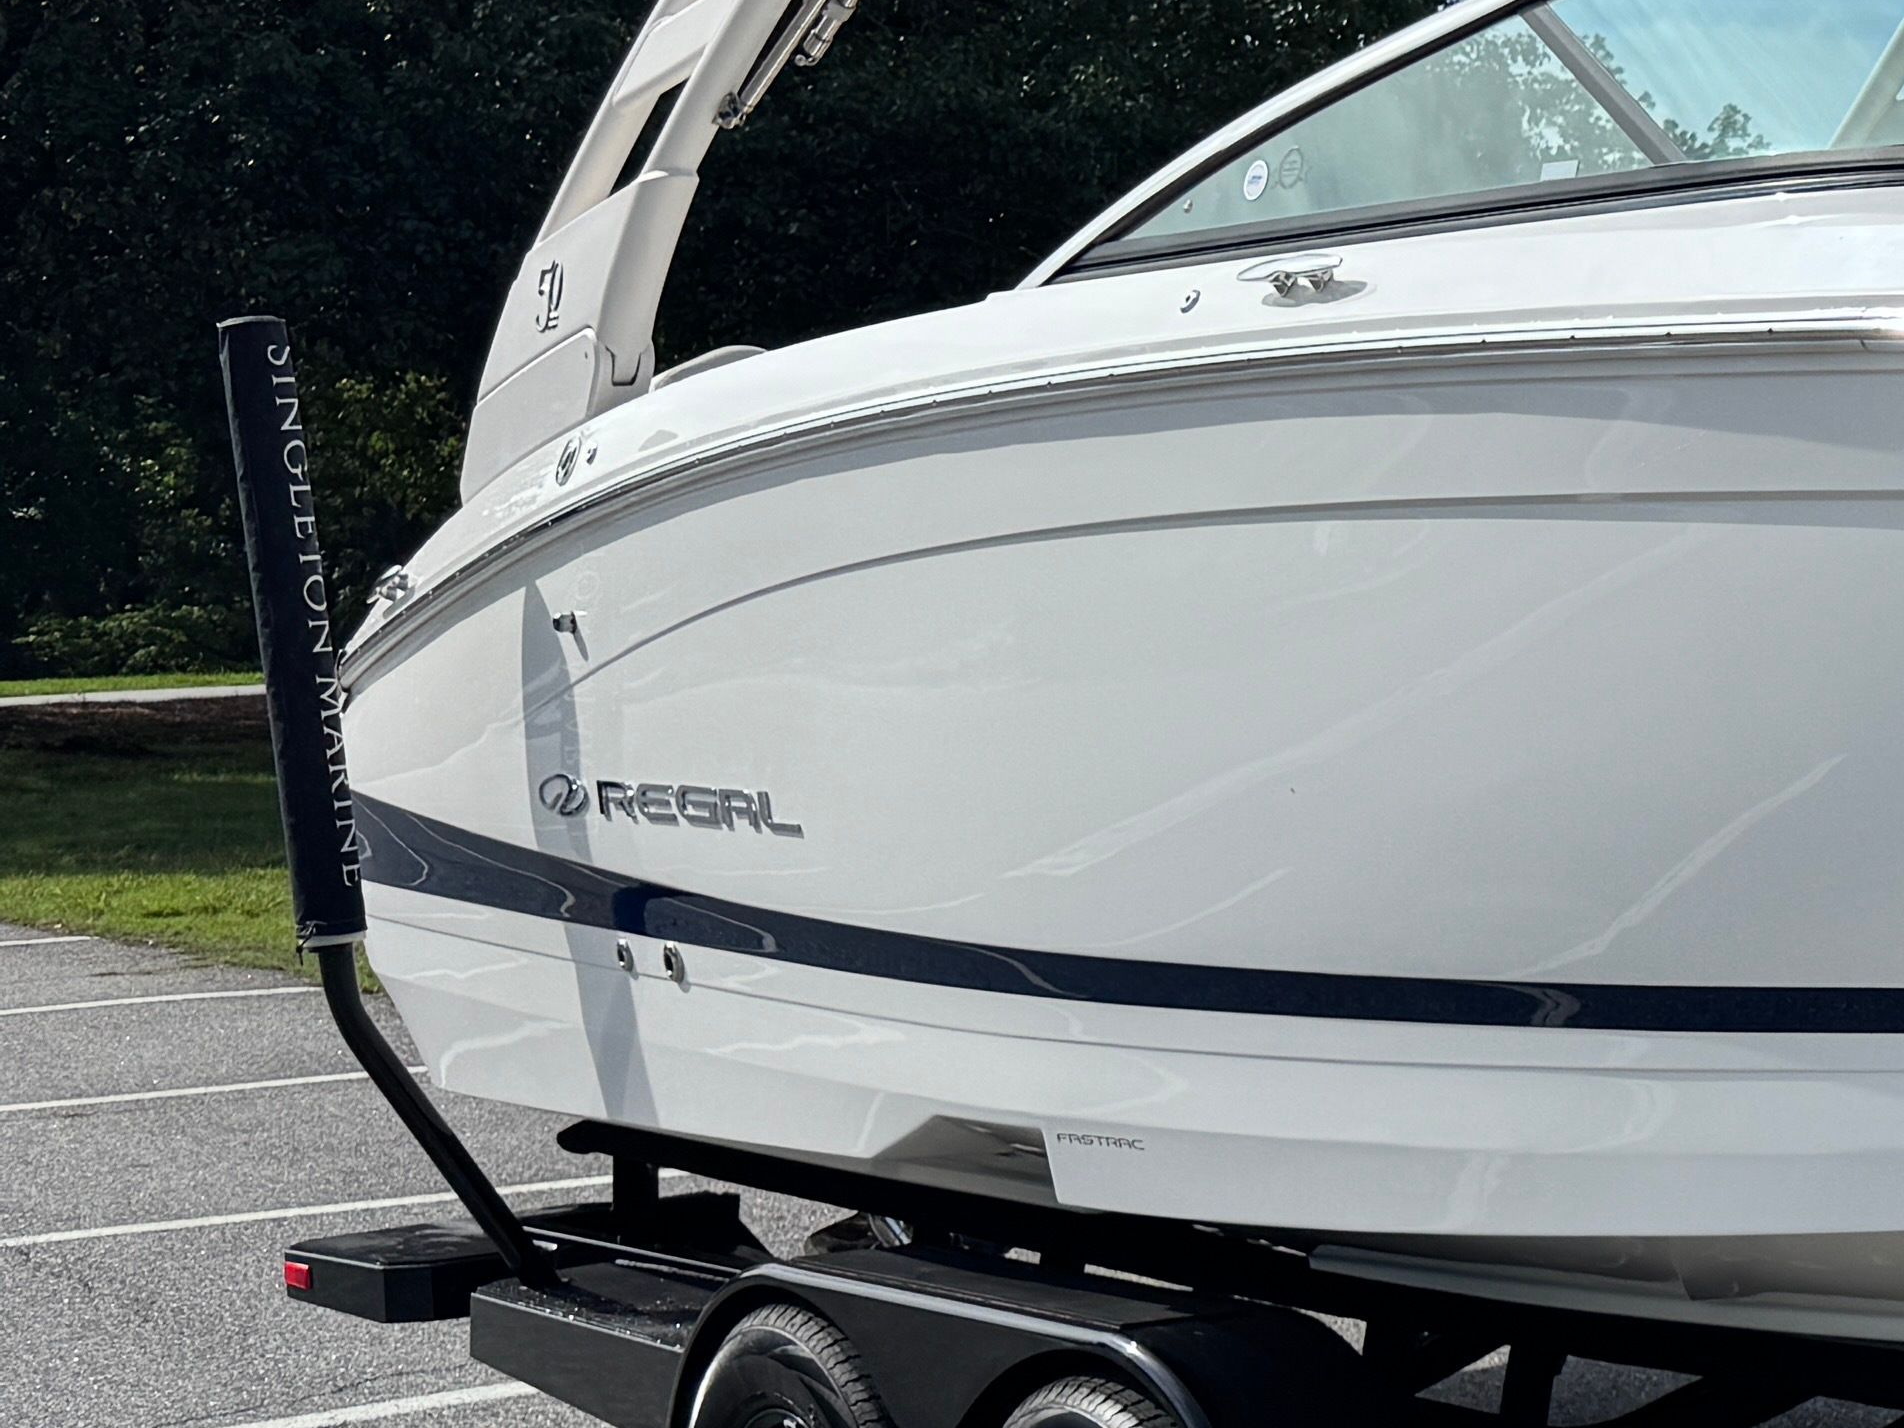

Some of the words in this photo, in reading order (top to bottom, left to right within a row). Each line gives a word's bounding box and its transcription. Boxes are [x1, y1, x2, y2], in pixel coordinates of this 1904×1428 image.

[265, 343, 334, 654] SINGLETON
[316, 674, 361, 888] MARINE
[596, 779, 804, 839] REGAL
[1056, 1132, 1146, 1151] FASTRAC
